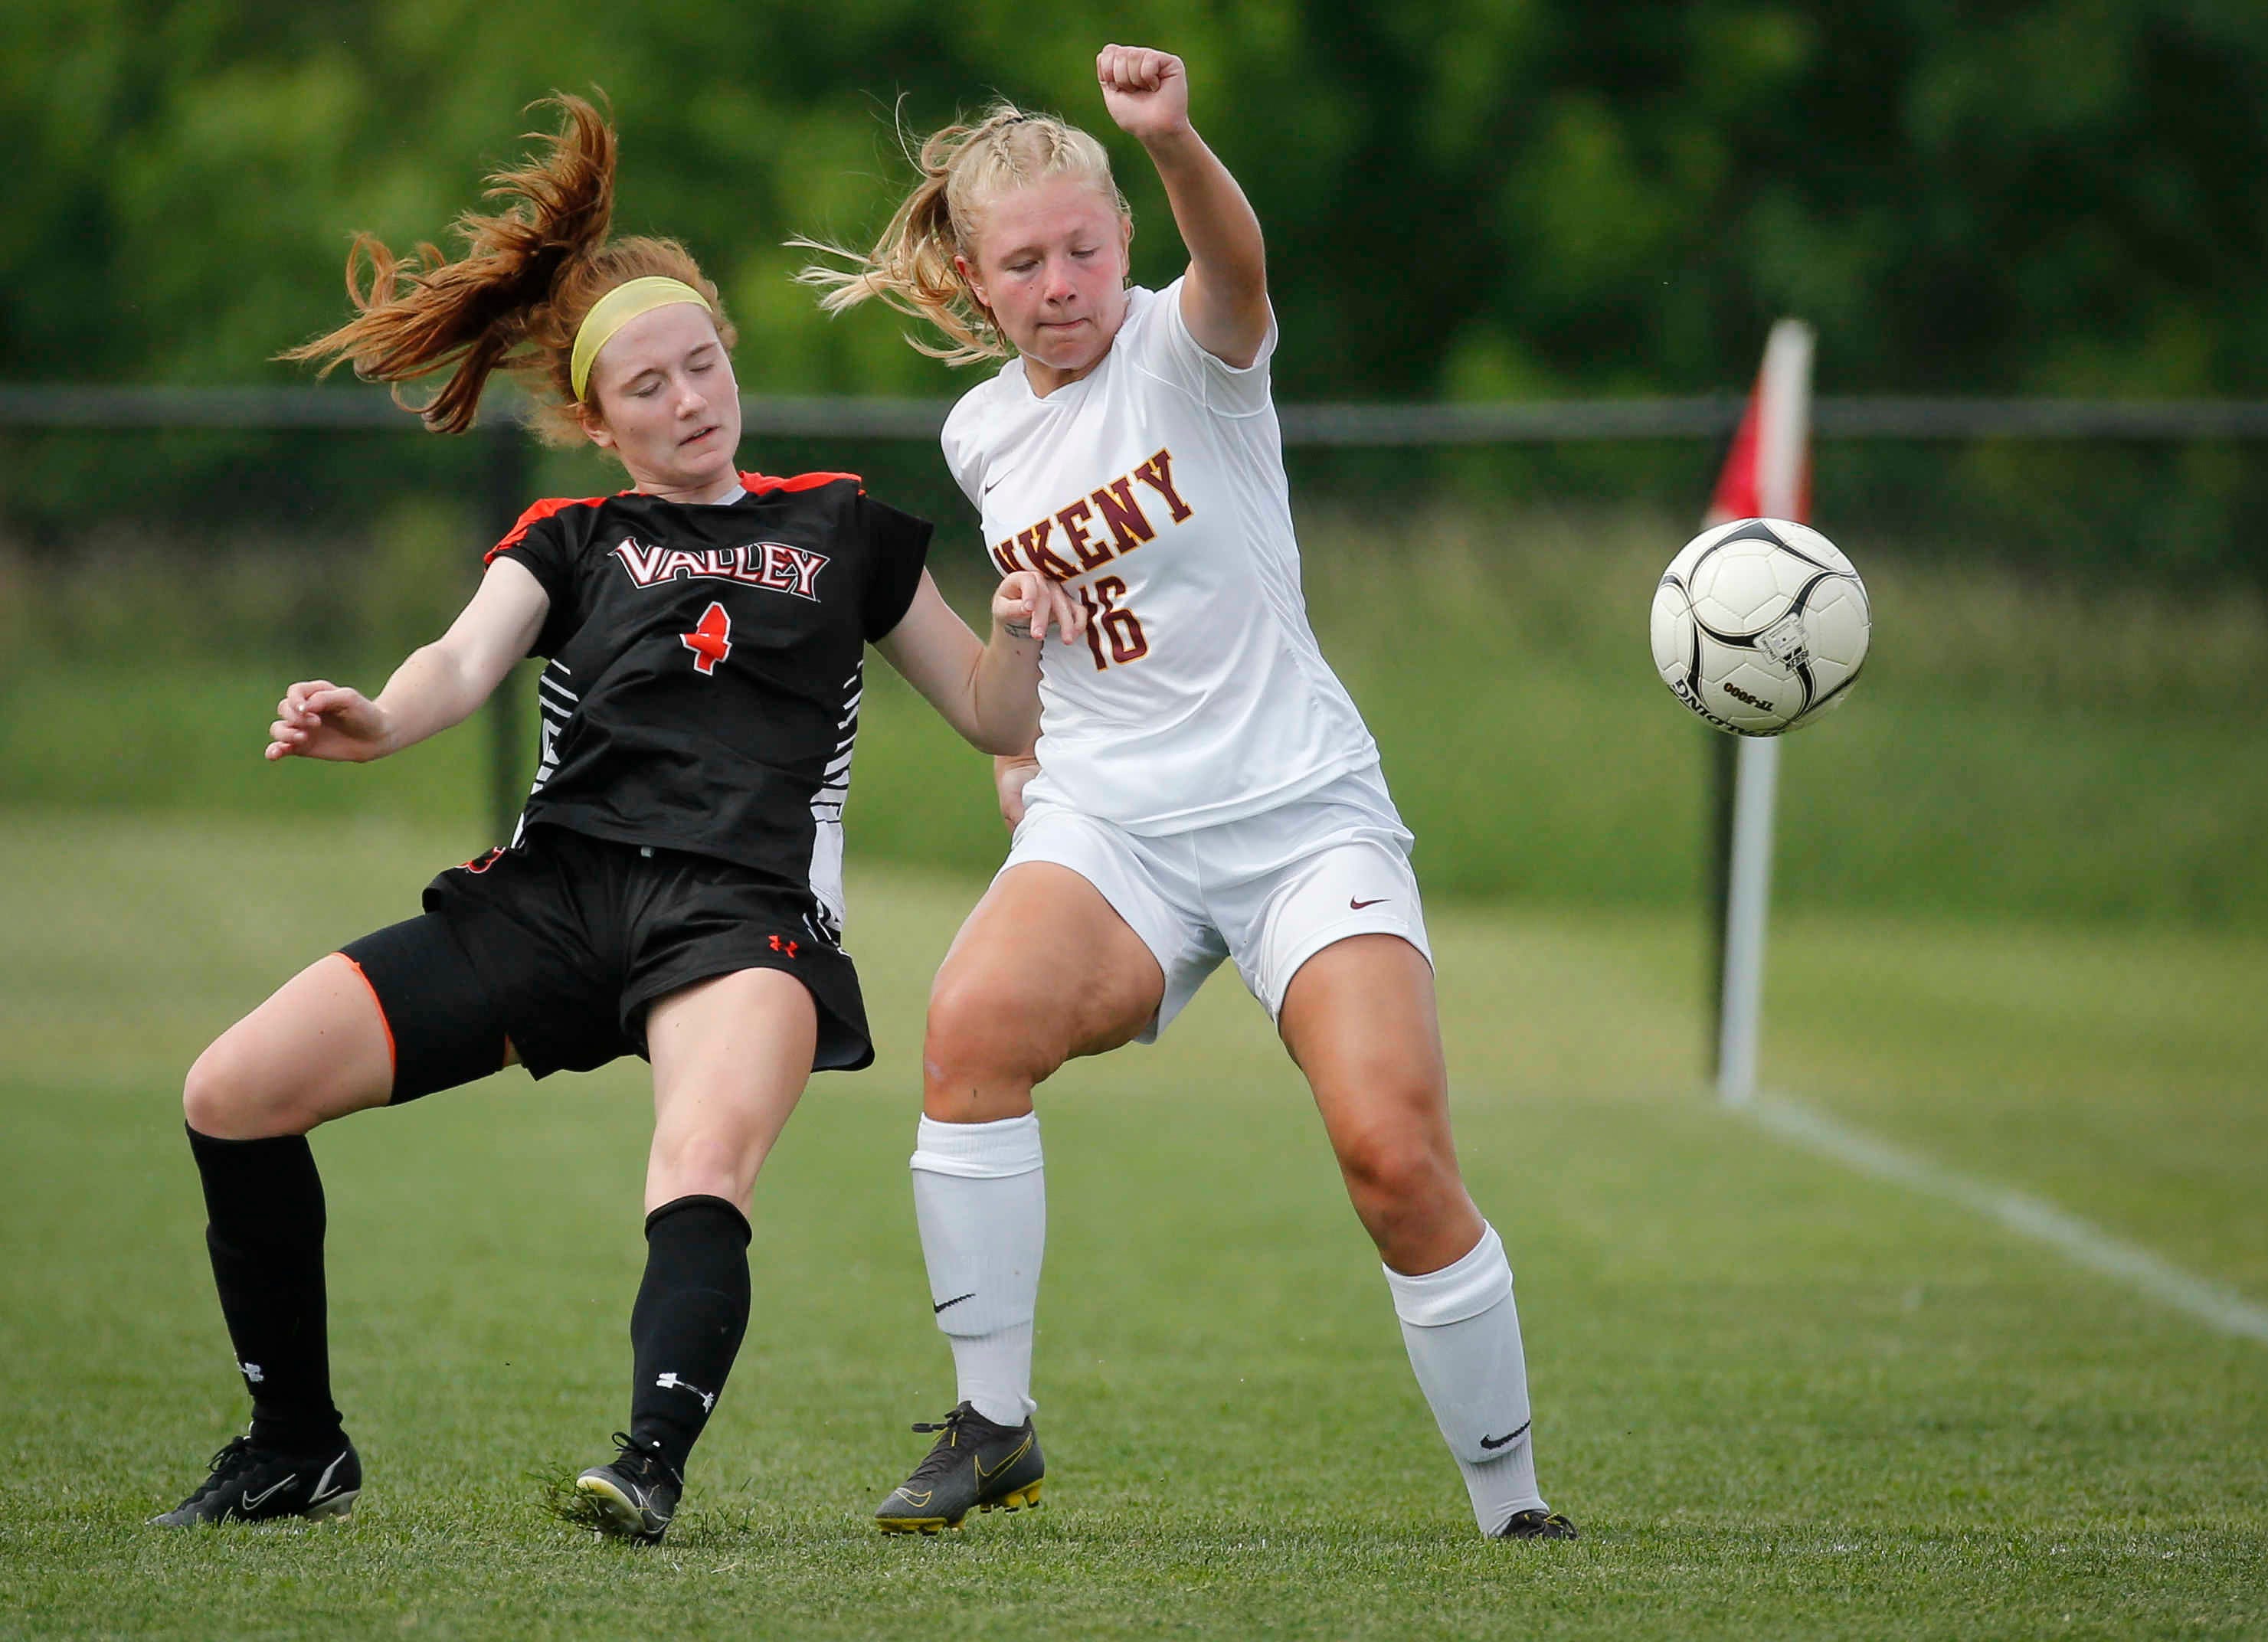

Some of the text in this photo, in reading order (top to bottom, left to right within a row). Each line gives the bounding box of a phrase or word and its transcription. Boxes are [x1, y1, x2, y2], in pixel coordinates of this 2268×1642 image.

[607, 536, 830, 603] VALLEY
[680, 601, 732, 675] 4
[1078, 575, 1149, 672] 16
[1674, 679, 1779, 737] ALDING
